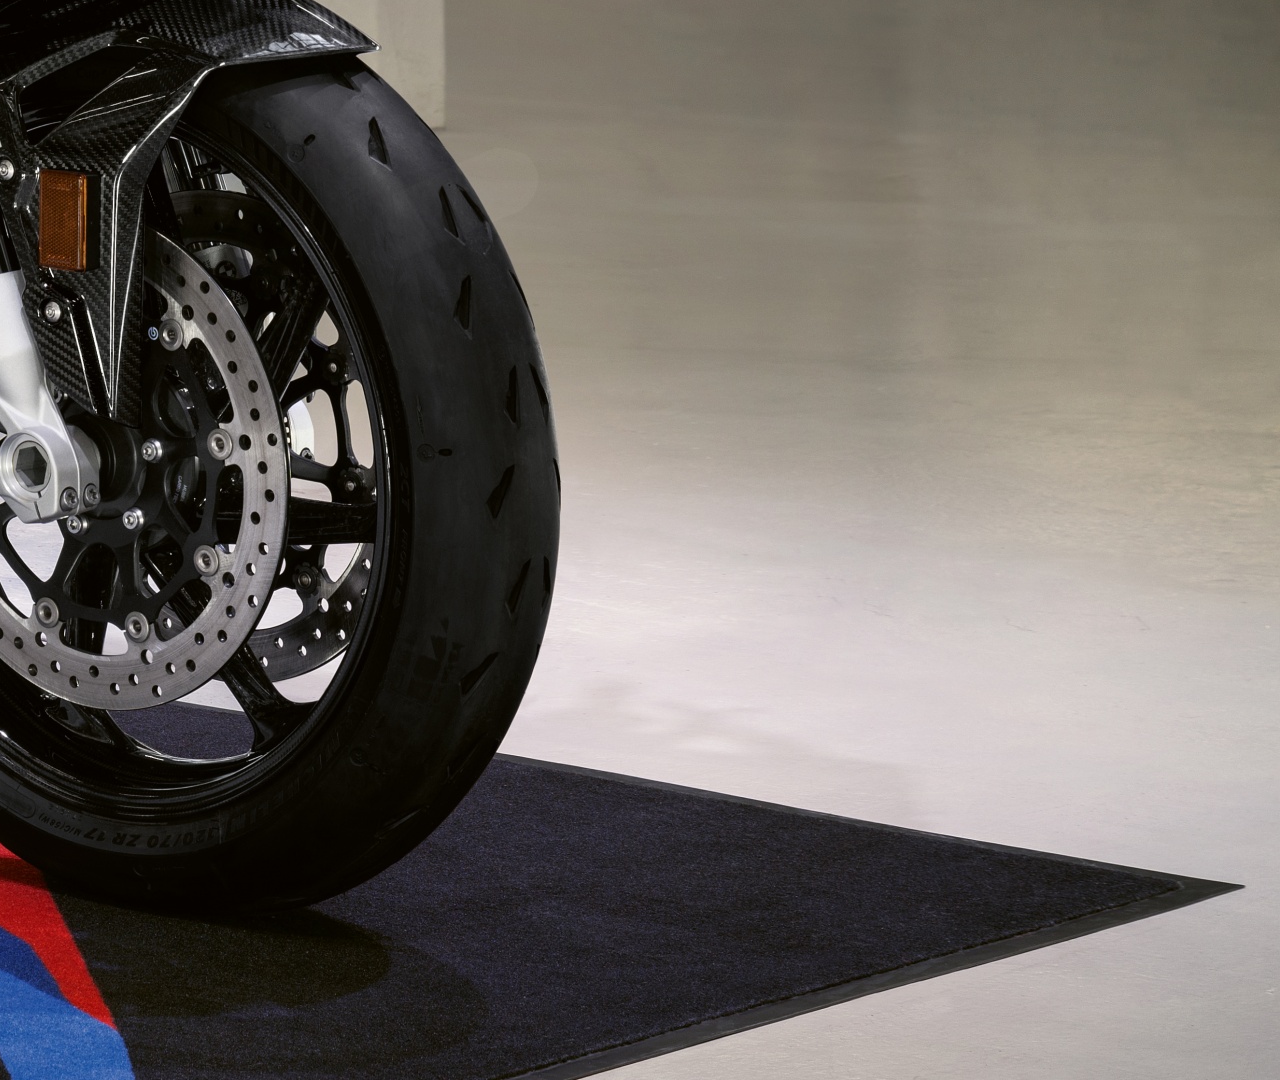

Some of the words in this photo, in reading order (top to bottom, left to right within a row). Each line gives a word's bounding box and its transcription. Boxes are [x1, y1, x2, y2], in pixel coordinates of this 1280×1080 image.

[83, 826, 106, 842] 17
[111, 832, 138, 848] ZR
[146, 826, 215, 849] 120/70
